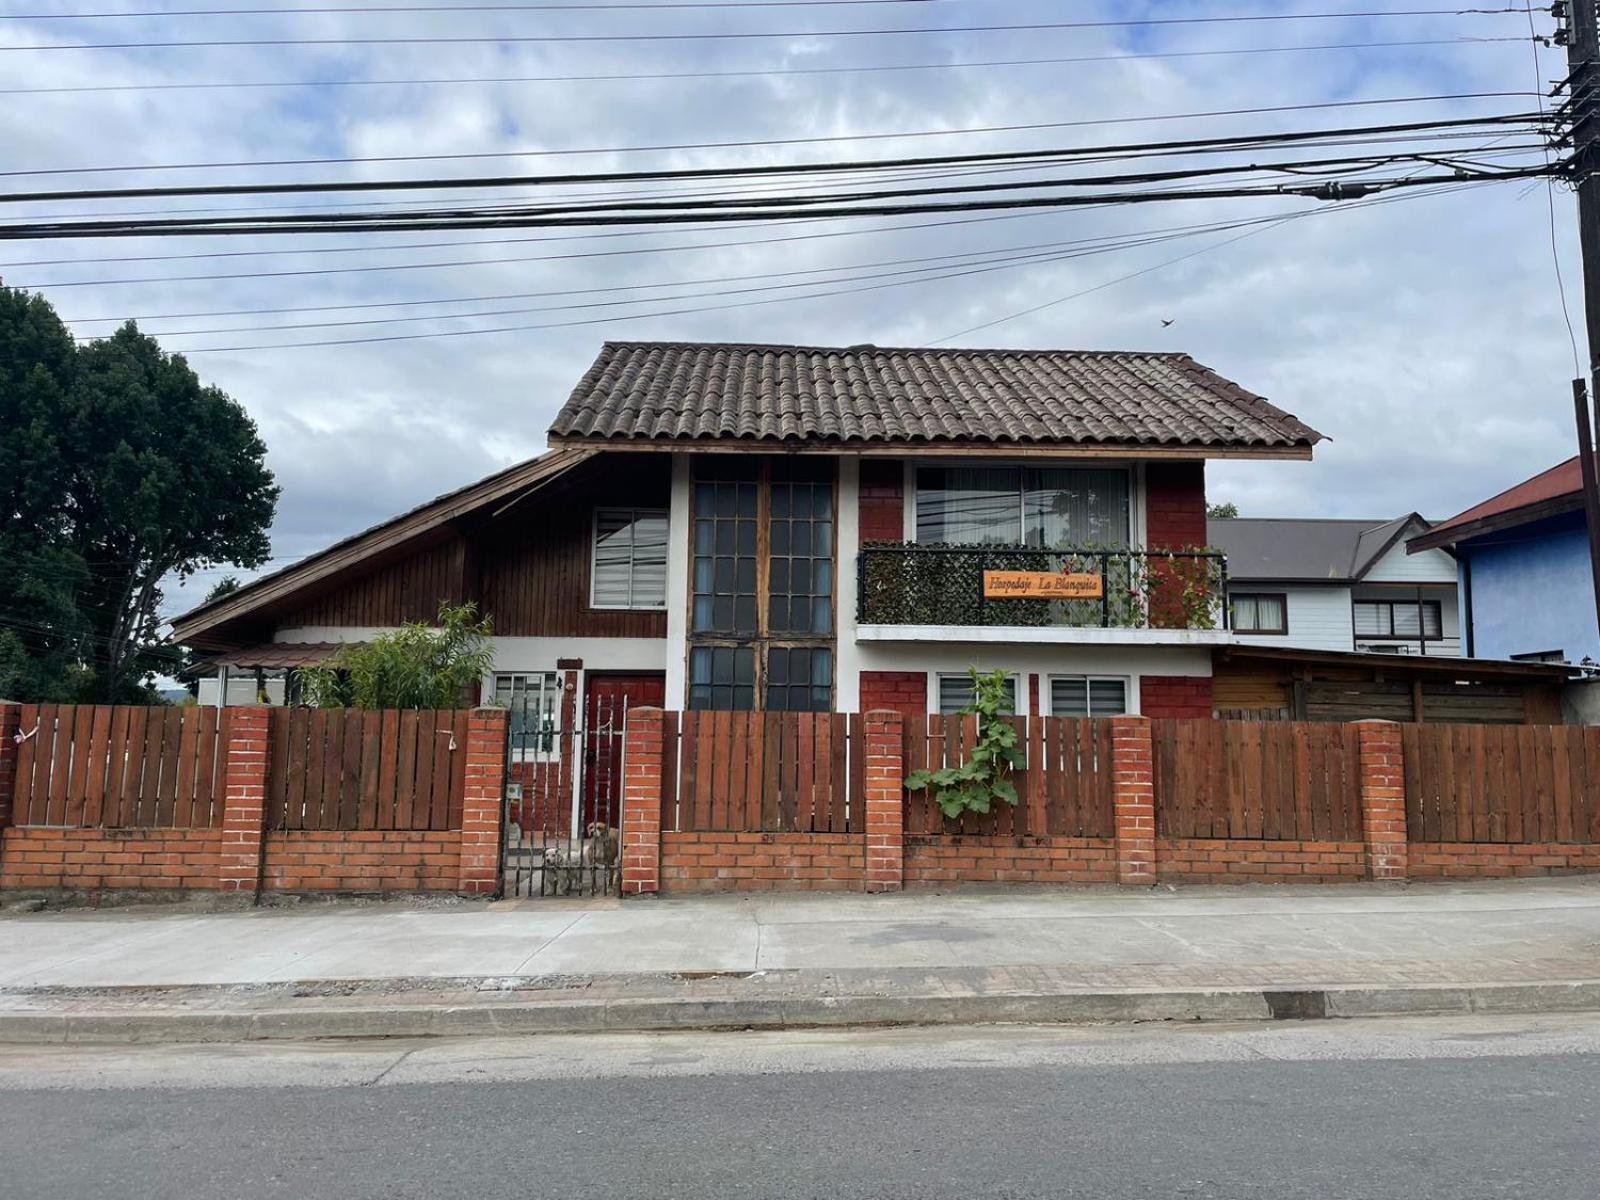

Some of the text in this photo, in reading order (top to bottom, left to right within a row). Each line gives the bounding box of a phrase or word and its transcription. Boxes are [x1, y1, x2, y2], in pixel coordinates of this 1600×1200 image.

[989, 577, 1097, 594] Hospedaje La Blanquita
